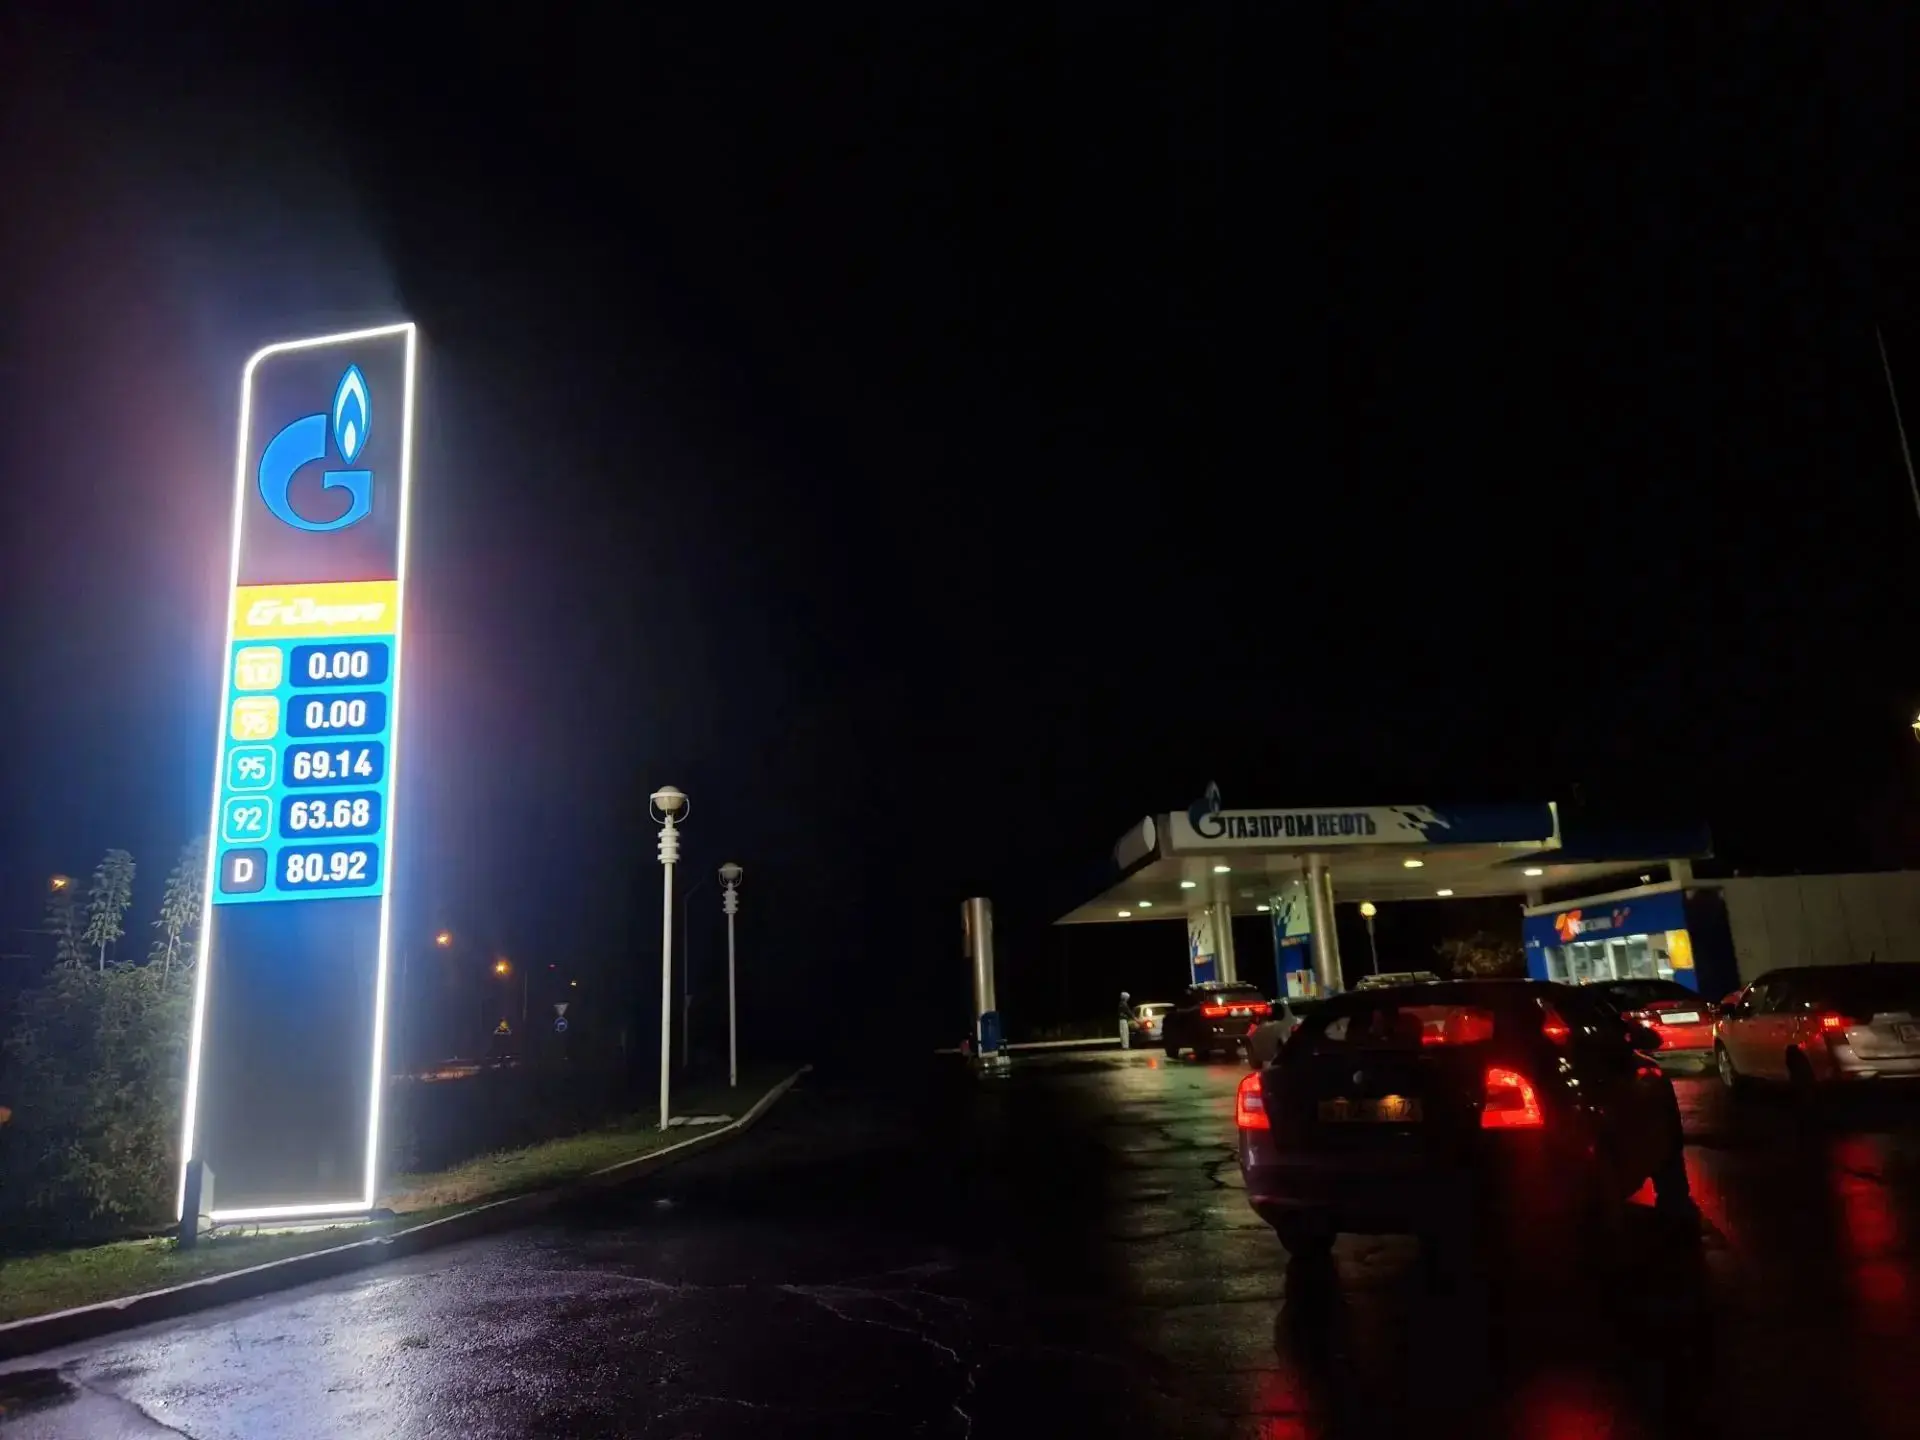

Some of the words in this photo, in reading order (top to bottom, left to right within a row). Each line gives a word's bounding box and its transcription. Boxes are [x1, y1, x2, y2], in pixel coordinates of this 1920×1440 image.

[308, 650, 368, 680] 0.00
[305, 700, 366, 729] 0.00
[237, 756, 266, 780] 95
[293, 749, 373, 780] 69.14
[233, 806, 262, 831] 92
[289, 799, 370, 831] 63.68
[233, 858, 254, 883] D
[286, 851, 368, 883] 80.92
